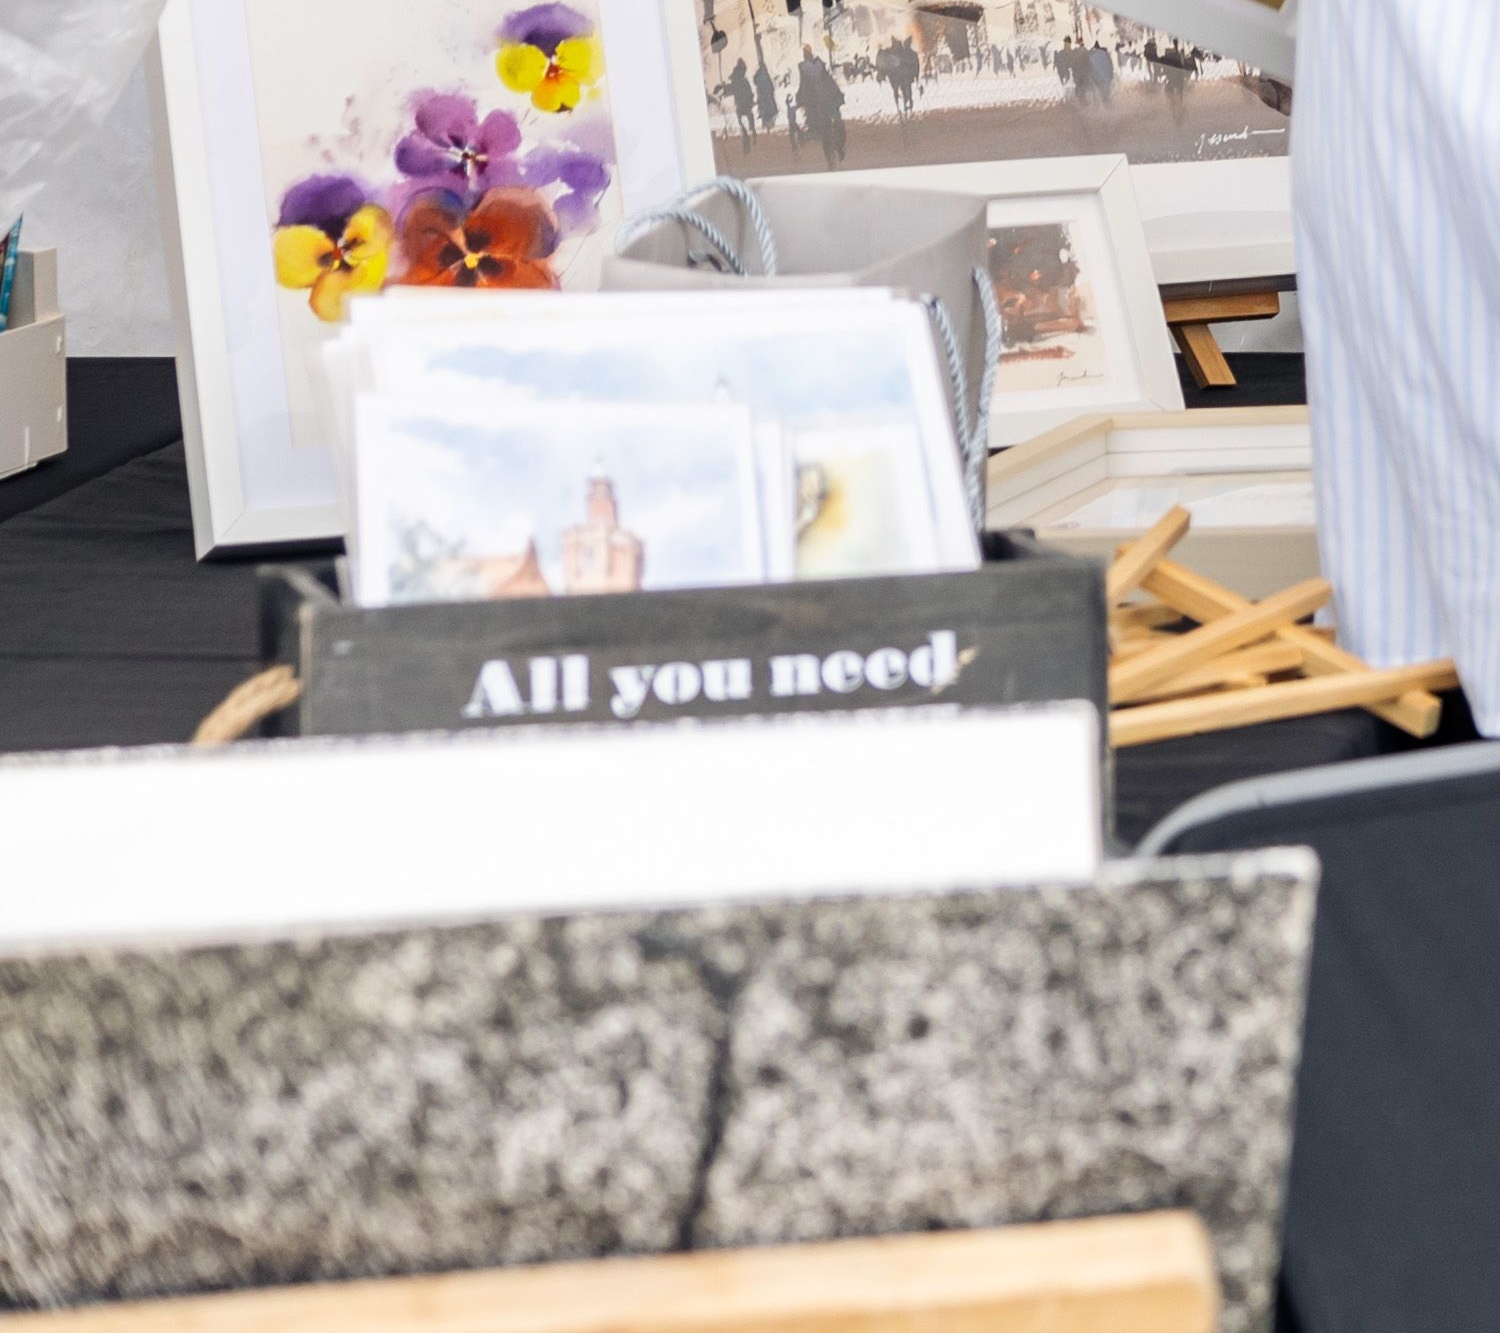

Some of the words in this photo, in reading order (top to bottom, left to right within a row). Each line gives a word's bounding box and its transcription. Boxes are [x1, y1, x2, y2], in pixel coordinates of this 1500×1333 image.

[461, 653, 590, 719] All
[609, 658, 753, 719] you
[769, 630, 957, 697] need
